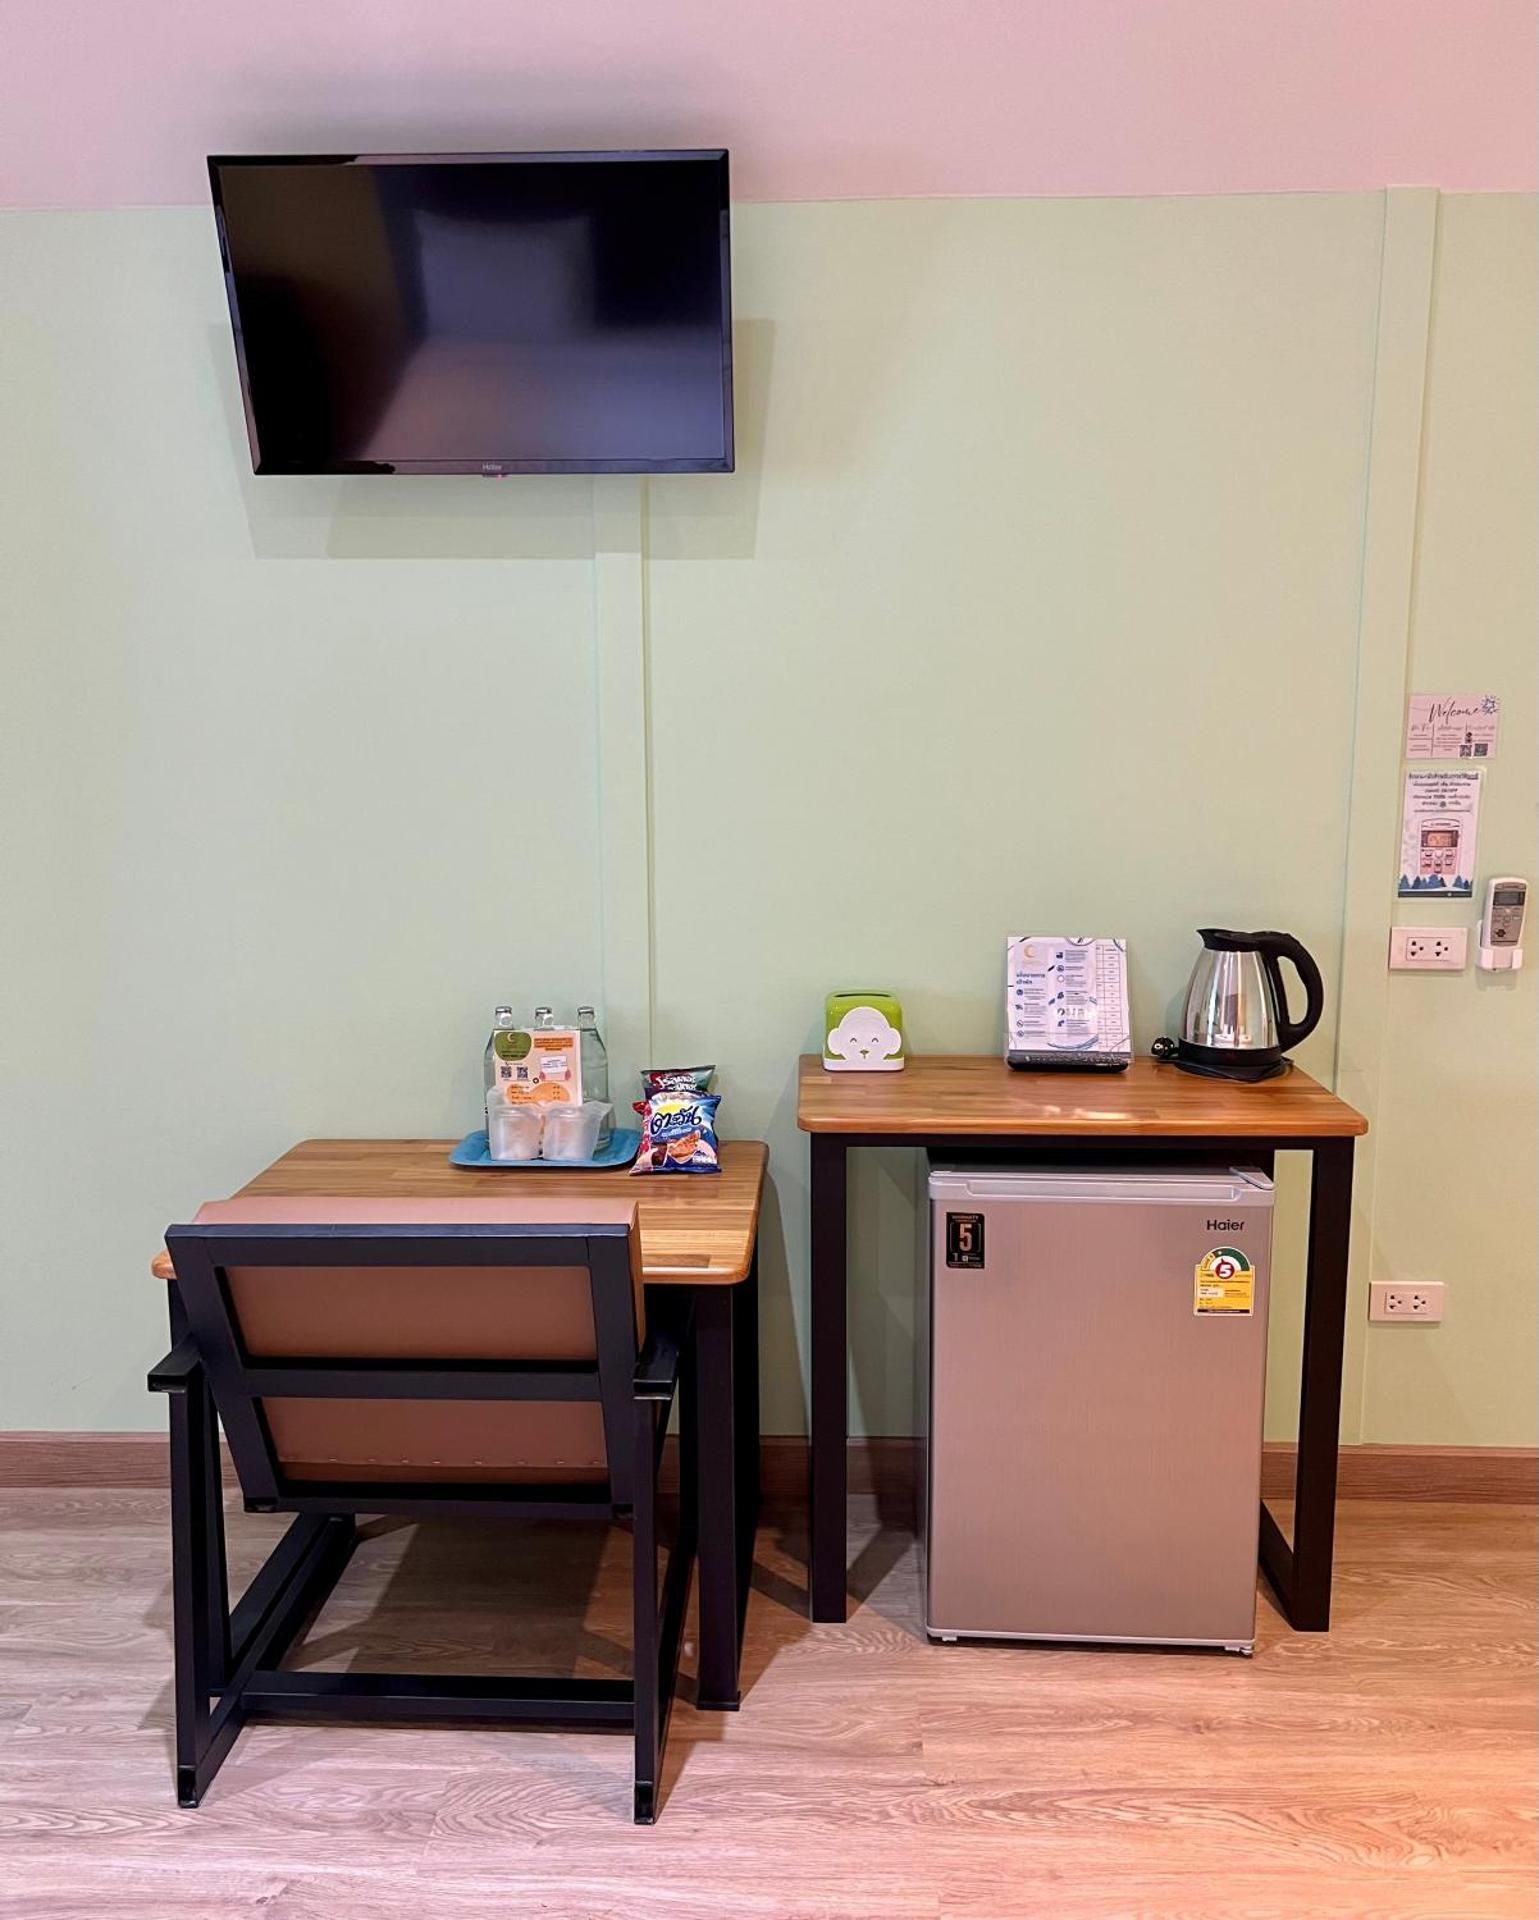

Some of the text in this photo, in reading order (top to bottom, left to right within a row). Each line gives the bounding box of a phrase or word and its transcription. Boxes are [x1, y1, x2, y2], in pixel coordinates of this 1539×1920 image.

[1428, 696, 1479, 724] Welcome
[650, 1105, 703, 1134] ตะวัน
[959, 1223, 973, 1251] 5
[1206, 1219, 1246, 1231] Haier
[1219, 1264, 1232, 1278] 5
